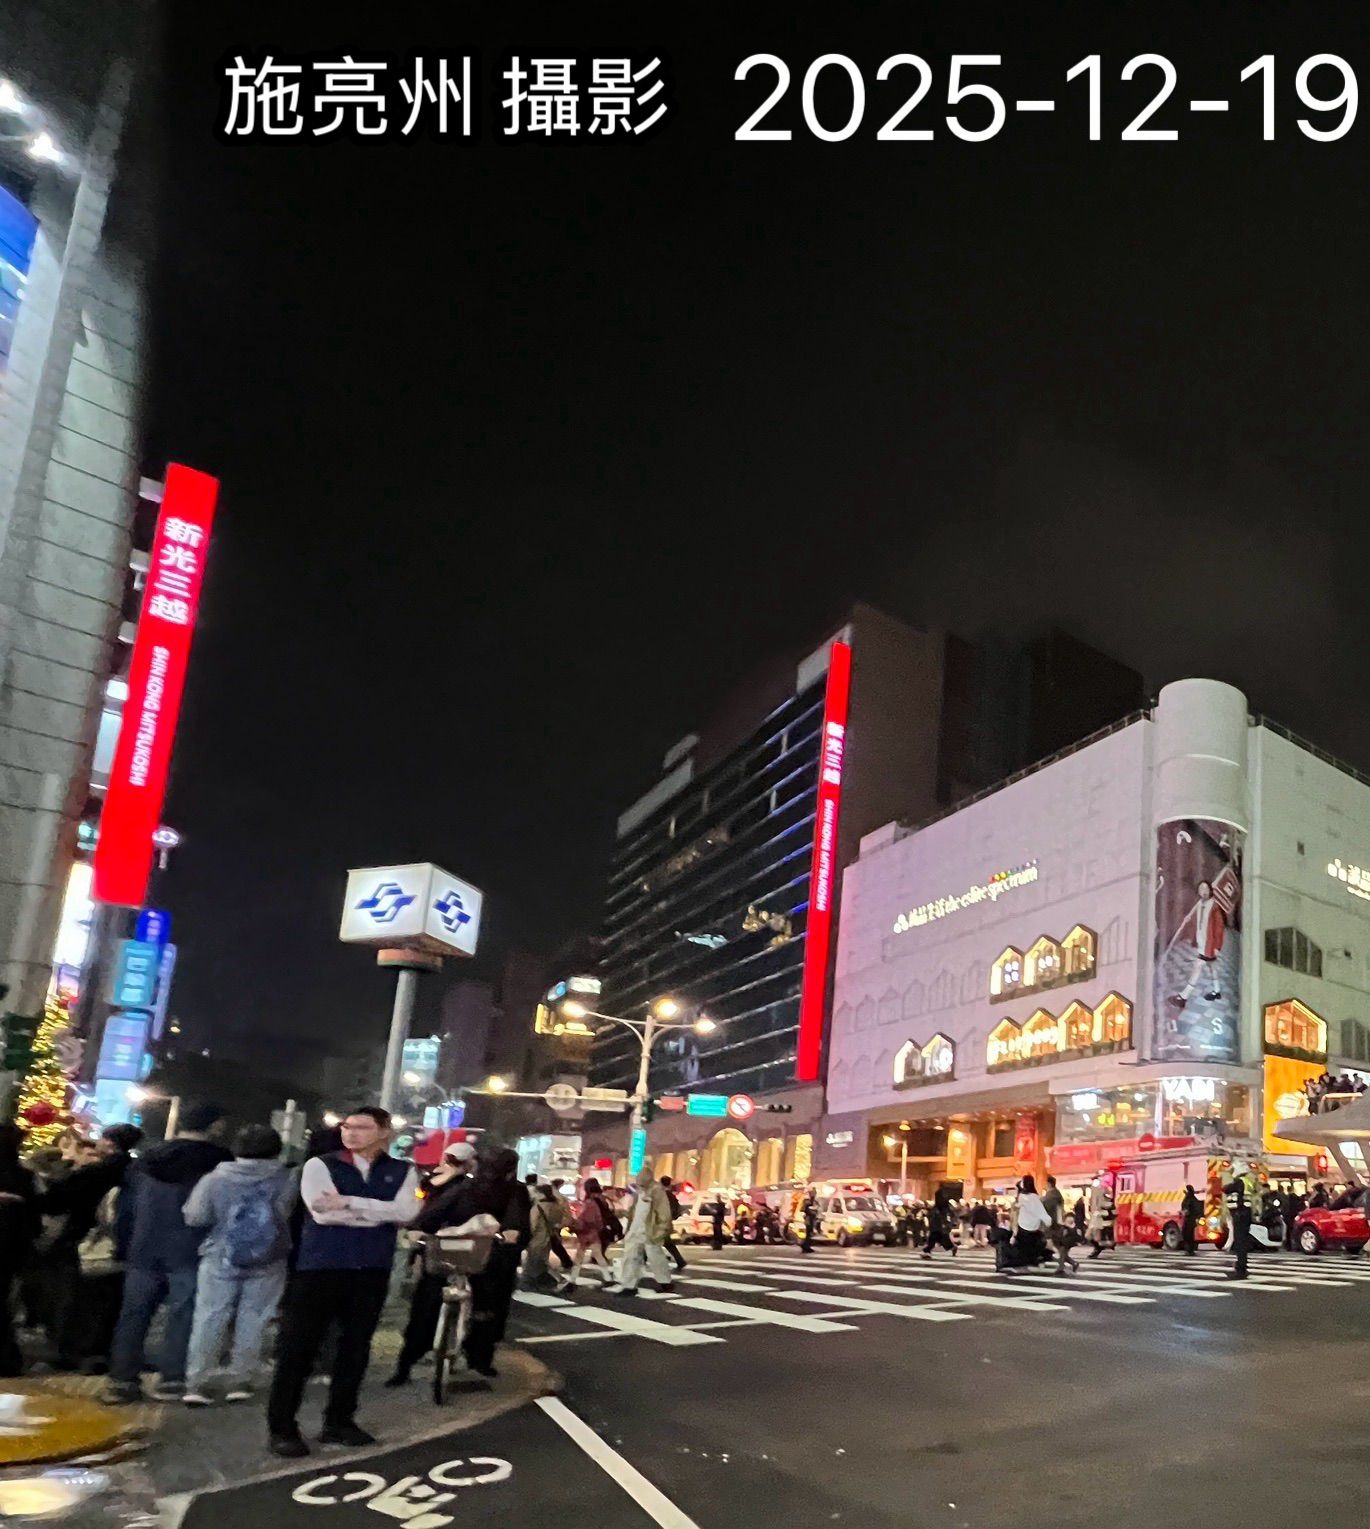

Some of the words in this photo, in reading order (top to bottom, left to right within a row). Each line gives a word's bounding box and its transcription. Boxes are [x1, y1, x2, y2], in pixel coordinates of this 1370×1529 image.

[148, 517, 204, 625] 新光三越
[128, 710, 159, 787] MITSUKOSHI
